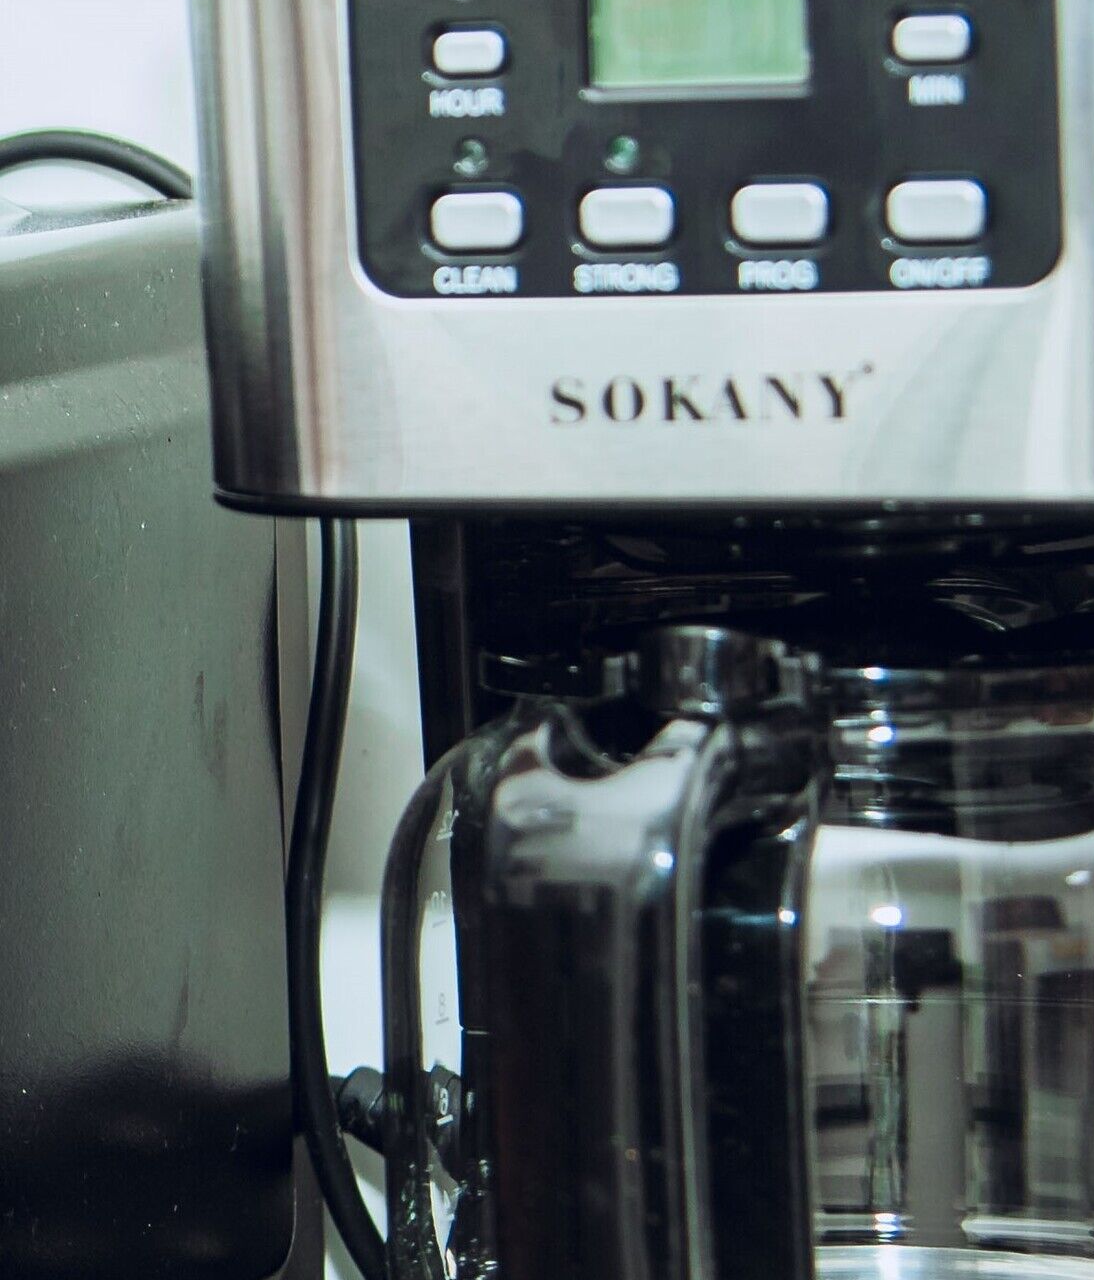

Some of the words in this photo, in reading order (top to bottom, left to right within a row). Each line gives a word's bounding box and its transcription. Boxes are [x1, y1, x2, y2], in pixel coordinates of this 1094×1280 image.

[429, 87, 505, 117] HOUR
[908, 75, 964, 105] MIN
[433, 266, 518, 294] CLEAN
[573, 262, 680, 293] STRONG
[738, 260, 820, 291] PROG
[550, 369, 860, 426] SOKANY
